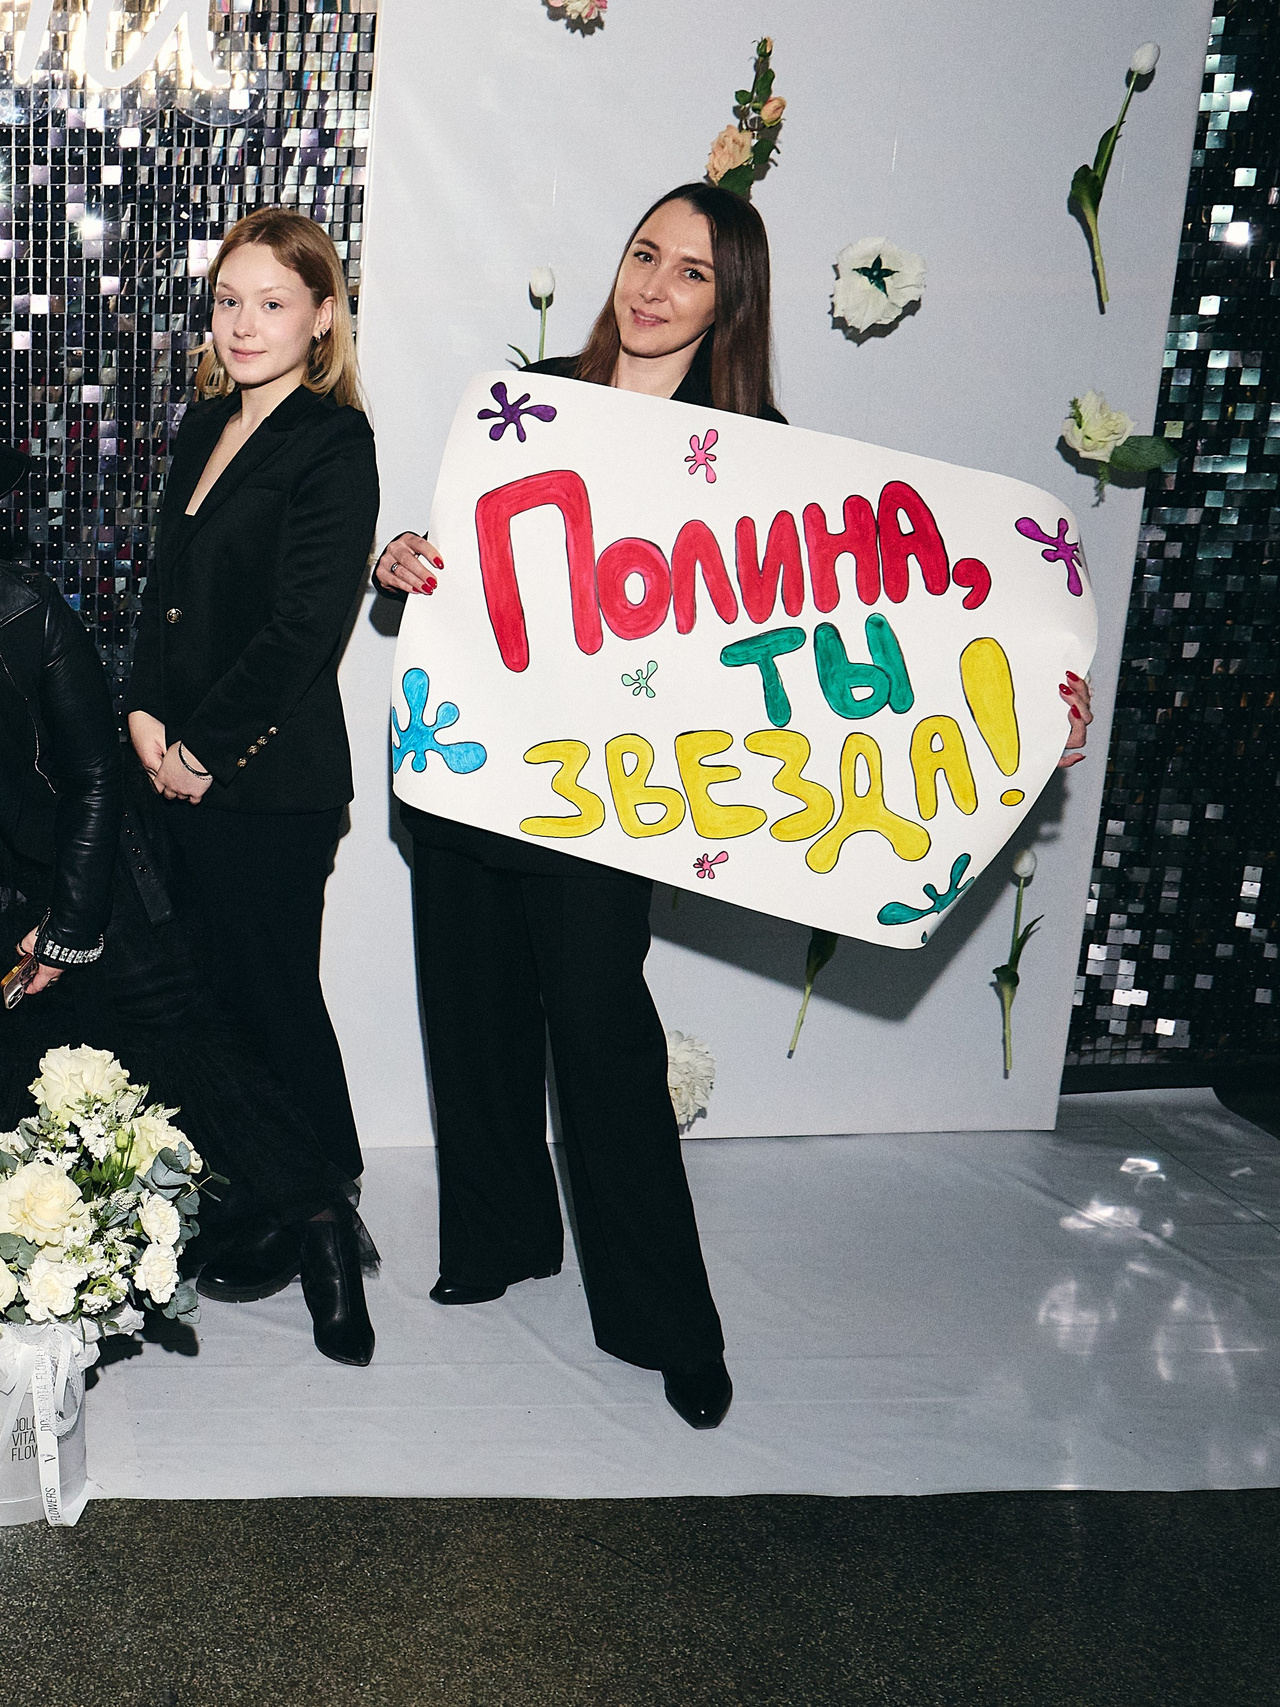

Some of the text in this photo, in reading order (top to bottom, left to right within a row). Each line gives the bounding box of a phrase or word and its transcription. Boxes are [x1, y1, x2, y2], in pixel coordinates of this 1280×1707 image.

[519, 636, 1026, 874] ЗВЕЗДА!
[12, 1415, 36, 1433] DOLC
[12, 1430, 36, 1446] VITA
[45, 1487, 61, 1522] FLOWERS
